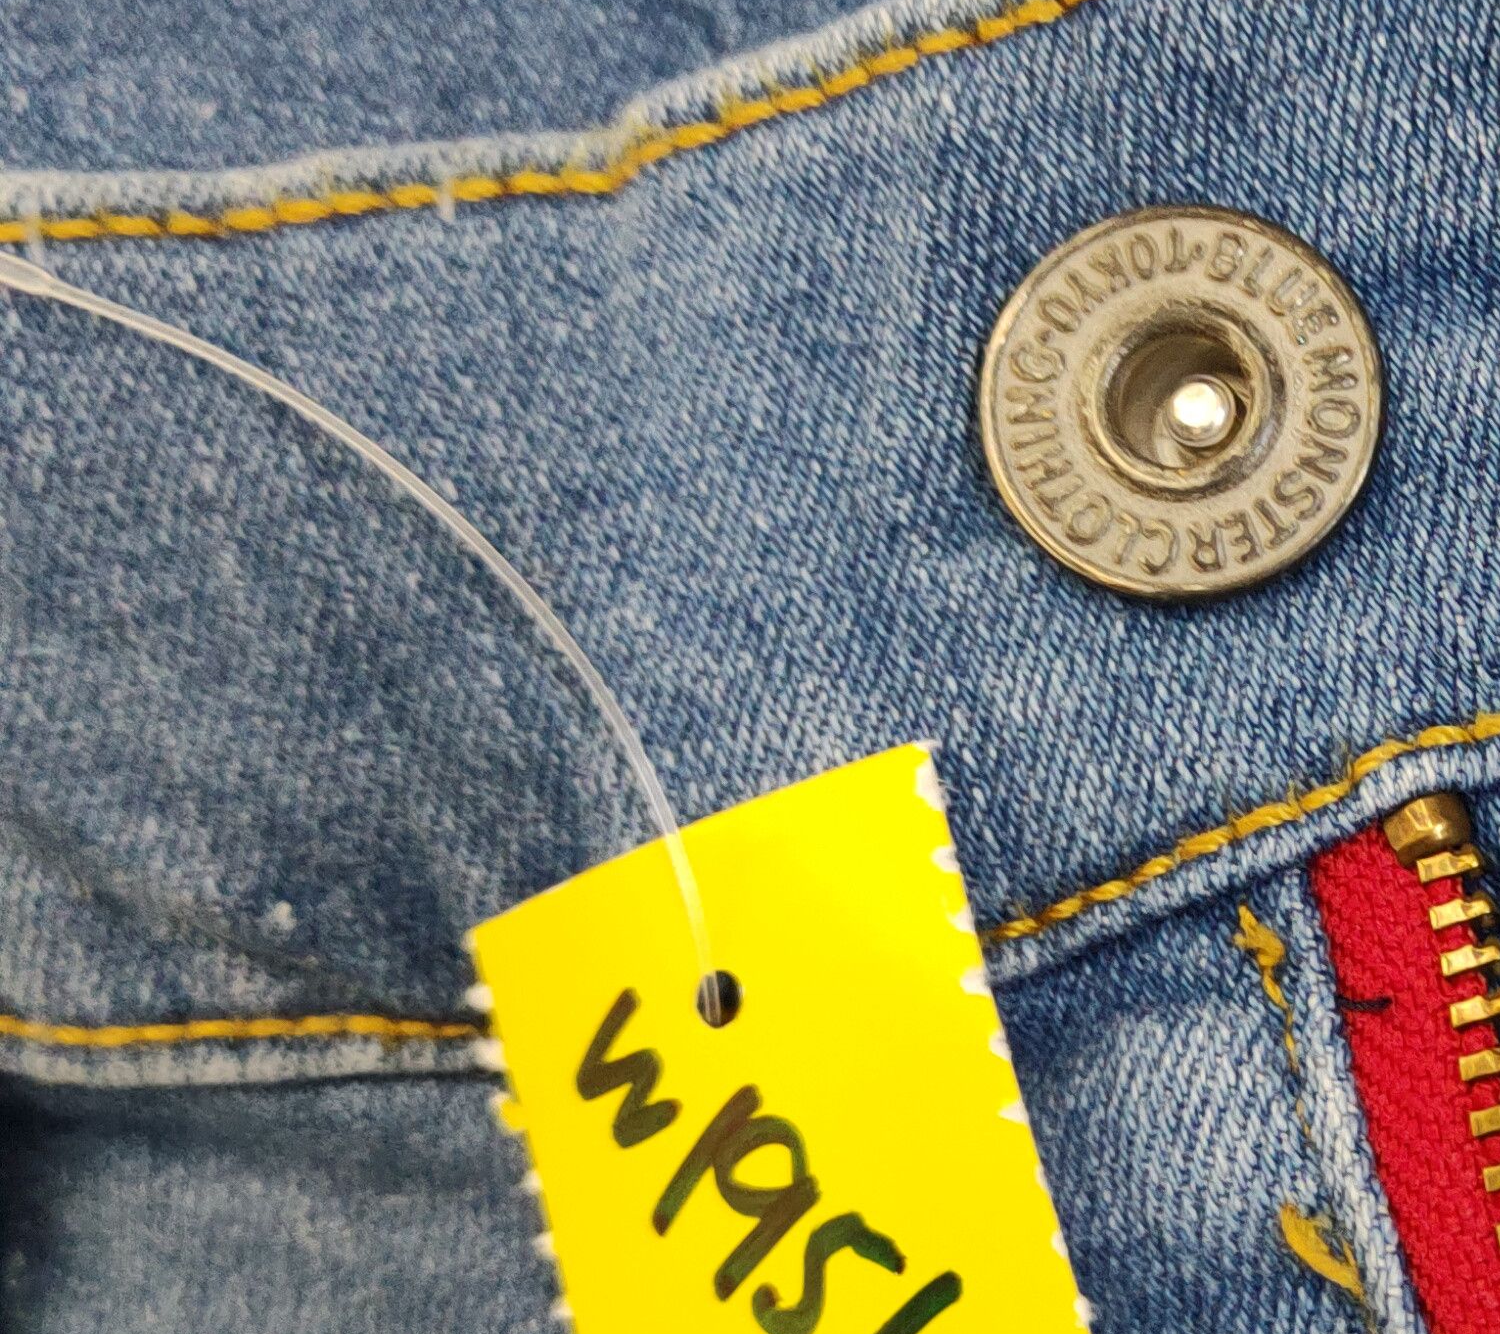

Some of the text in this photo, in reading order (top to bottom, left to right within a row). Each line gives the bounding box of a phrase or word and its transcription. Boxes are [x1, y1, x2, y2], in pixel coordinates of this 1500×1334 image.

[1038, 224, 1188, 335] TOKYO
[1004, 230, 1363, 577] BLUE MONSTER CLOTHING
